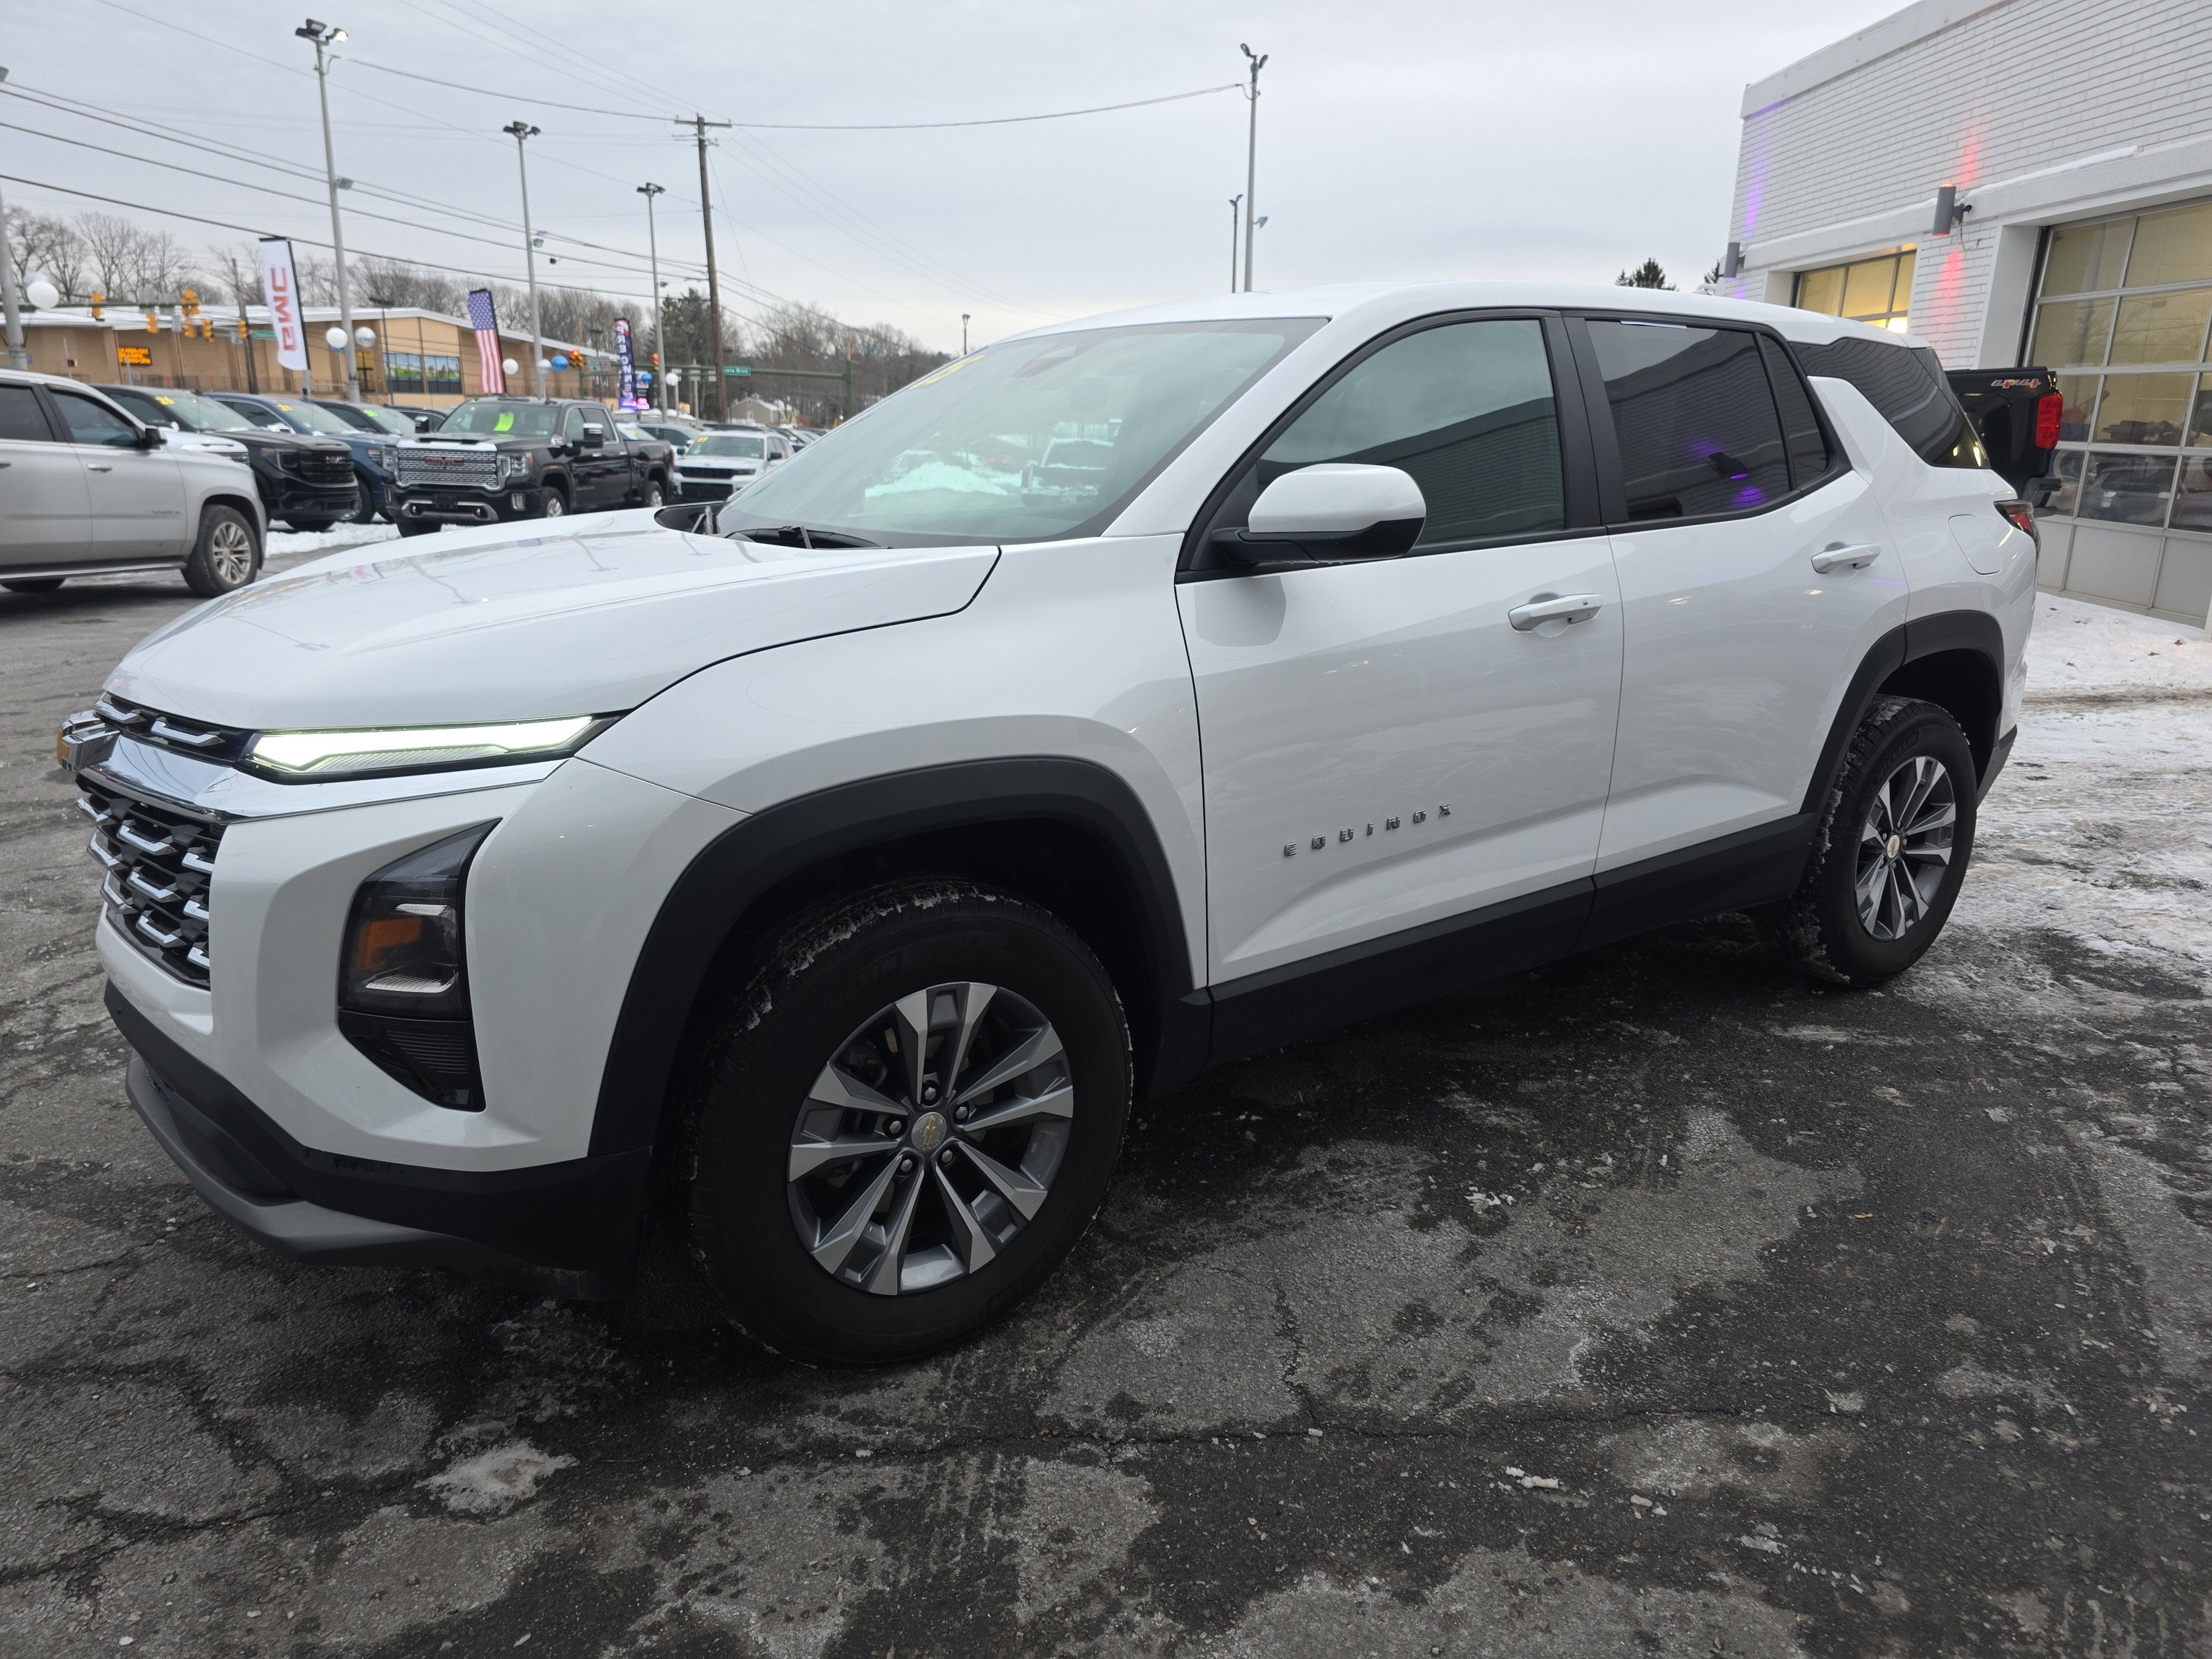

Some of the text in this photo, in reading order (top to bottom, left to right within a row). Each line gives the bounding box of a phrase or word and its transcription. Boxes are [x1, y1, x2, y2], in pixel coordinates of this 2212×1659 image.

[271, 267, 297, 351] GMC
[424, 456, 464, 467] GMC
[1283, 802, 1452, 857] EQUINOX
